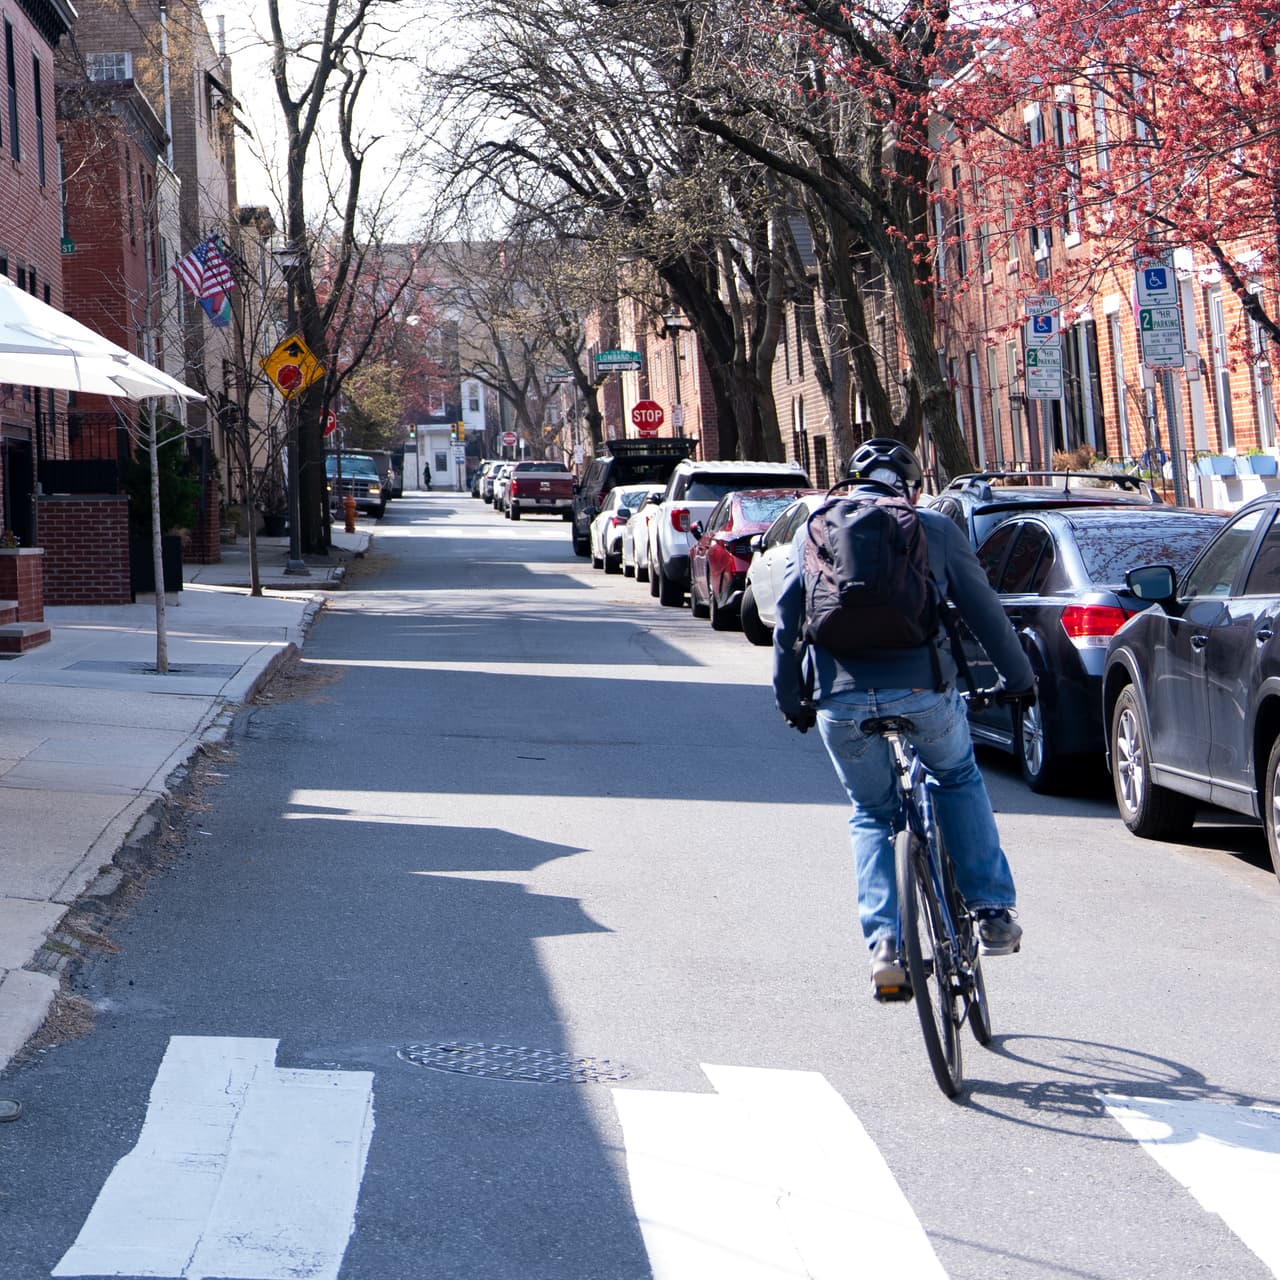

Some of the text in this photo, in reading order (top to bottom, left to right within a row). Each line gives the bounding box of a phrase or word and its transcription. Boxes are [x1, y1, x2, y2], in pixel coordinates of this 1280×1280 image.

[1142, 312, 1151, 329] 2
[1153, 320, 1179, 329] PARKING
[1028, 350, 1037, 365] 2
[633, 410, 663, 422] STOP
